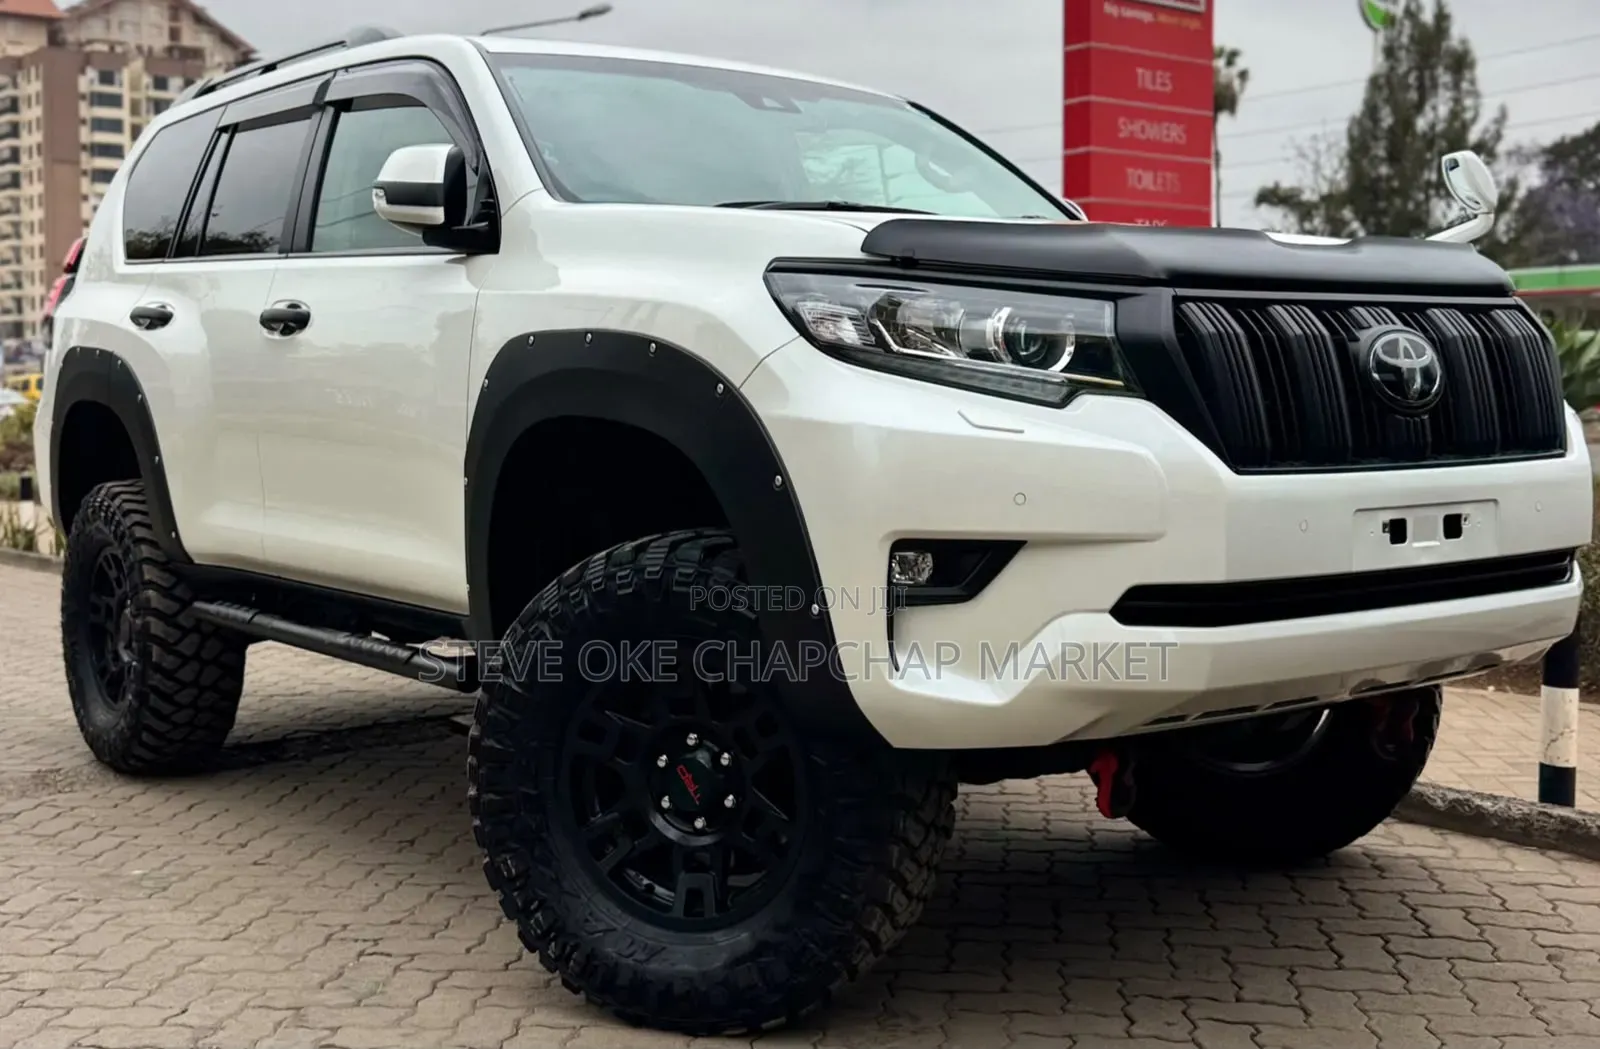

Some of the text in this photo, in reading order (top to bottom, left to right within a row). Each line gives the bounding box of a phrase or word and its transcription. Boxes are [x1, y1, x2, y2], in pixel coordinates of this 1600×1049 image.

[1136, 67, 1172, 93] TILES
[1118, 117, 1187, 144] SHOWERS
[1126, 168, 1180, 193] TOILETS
